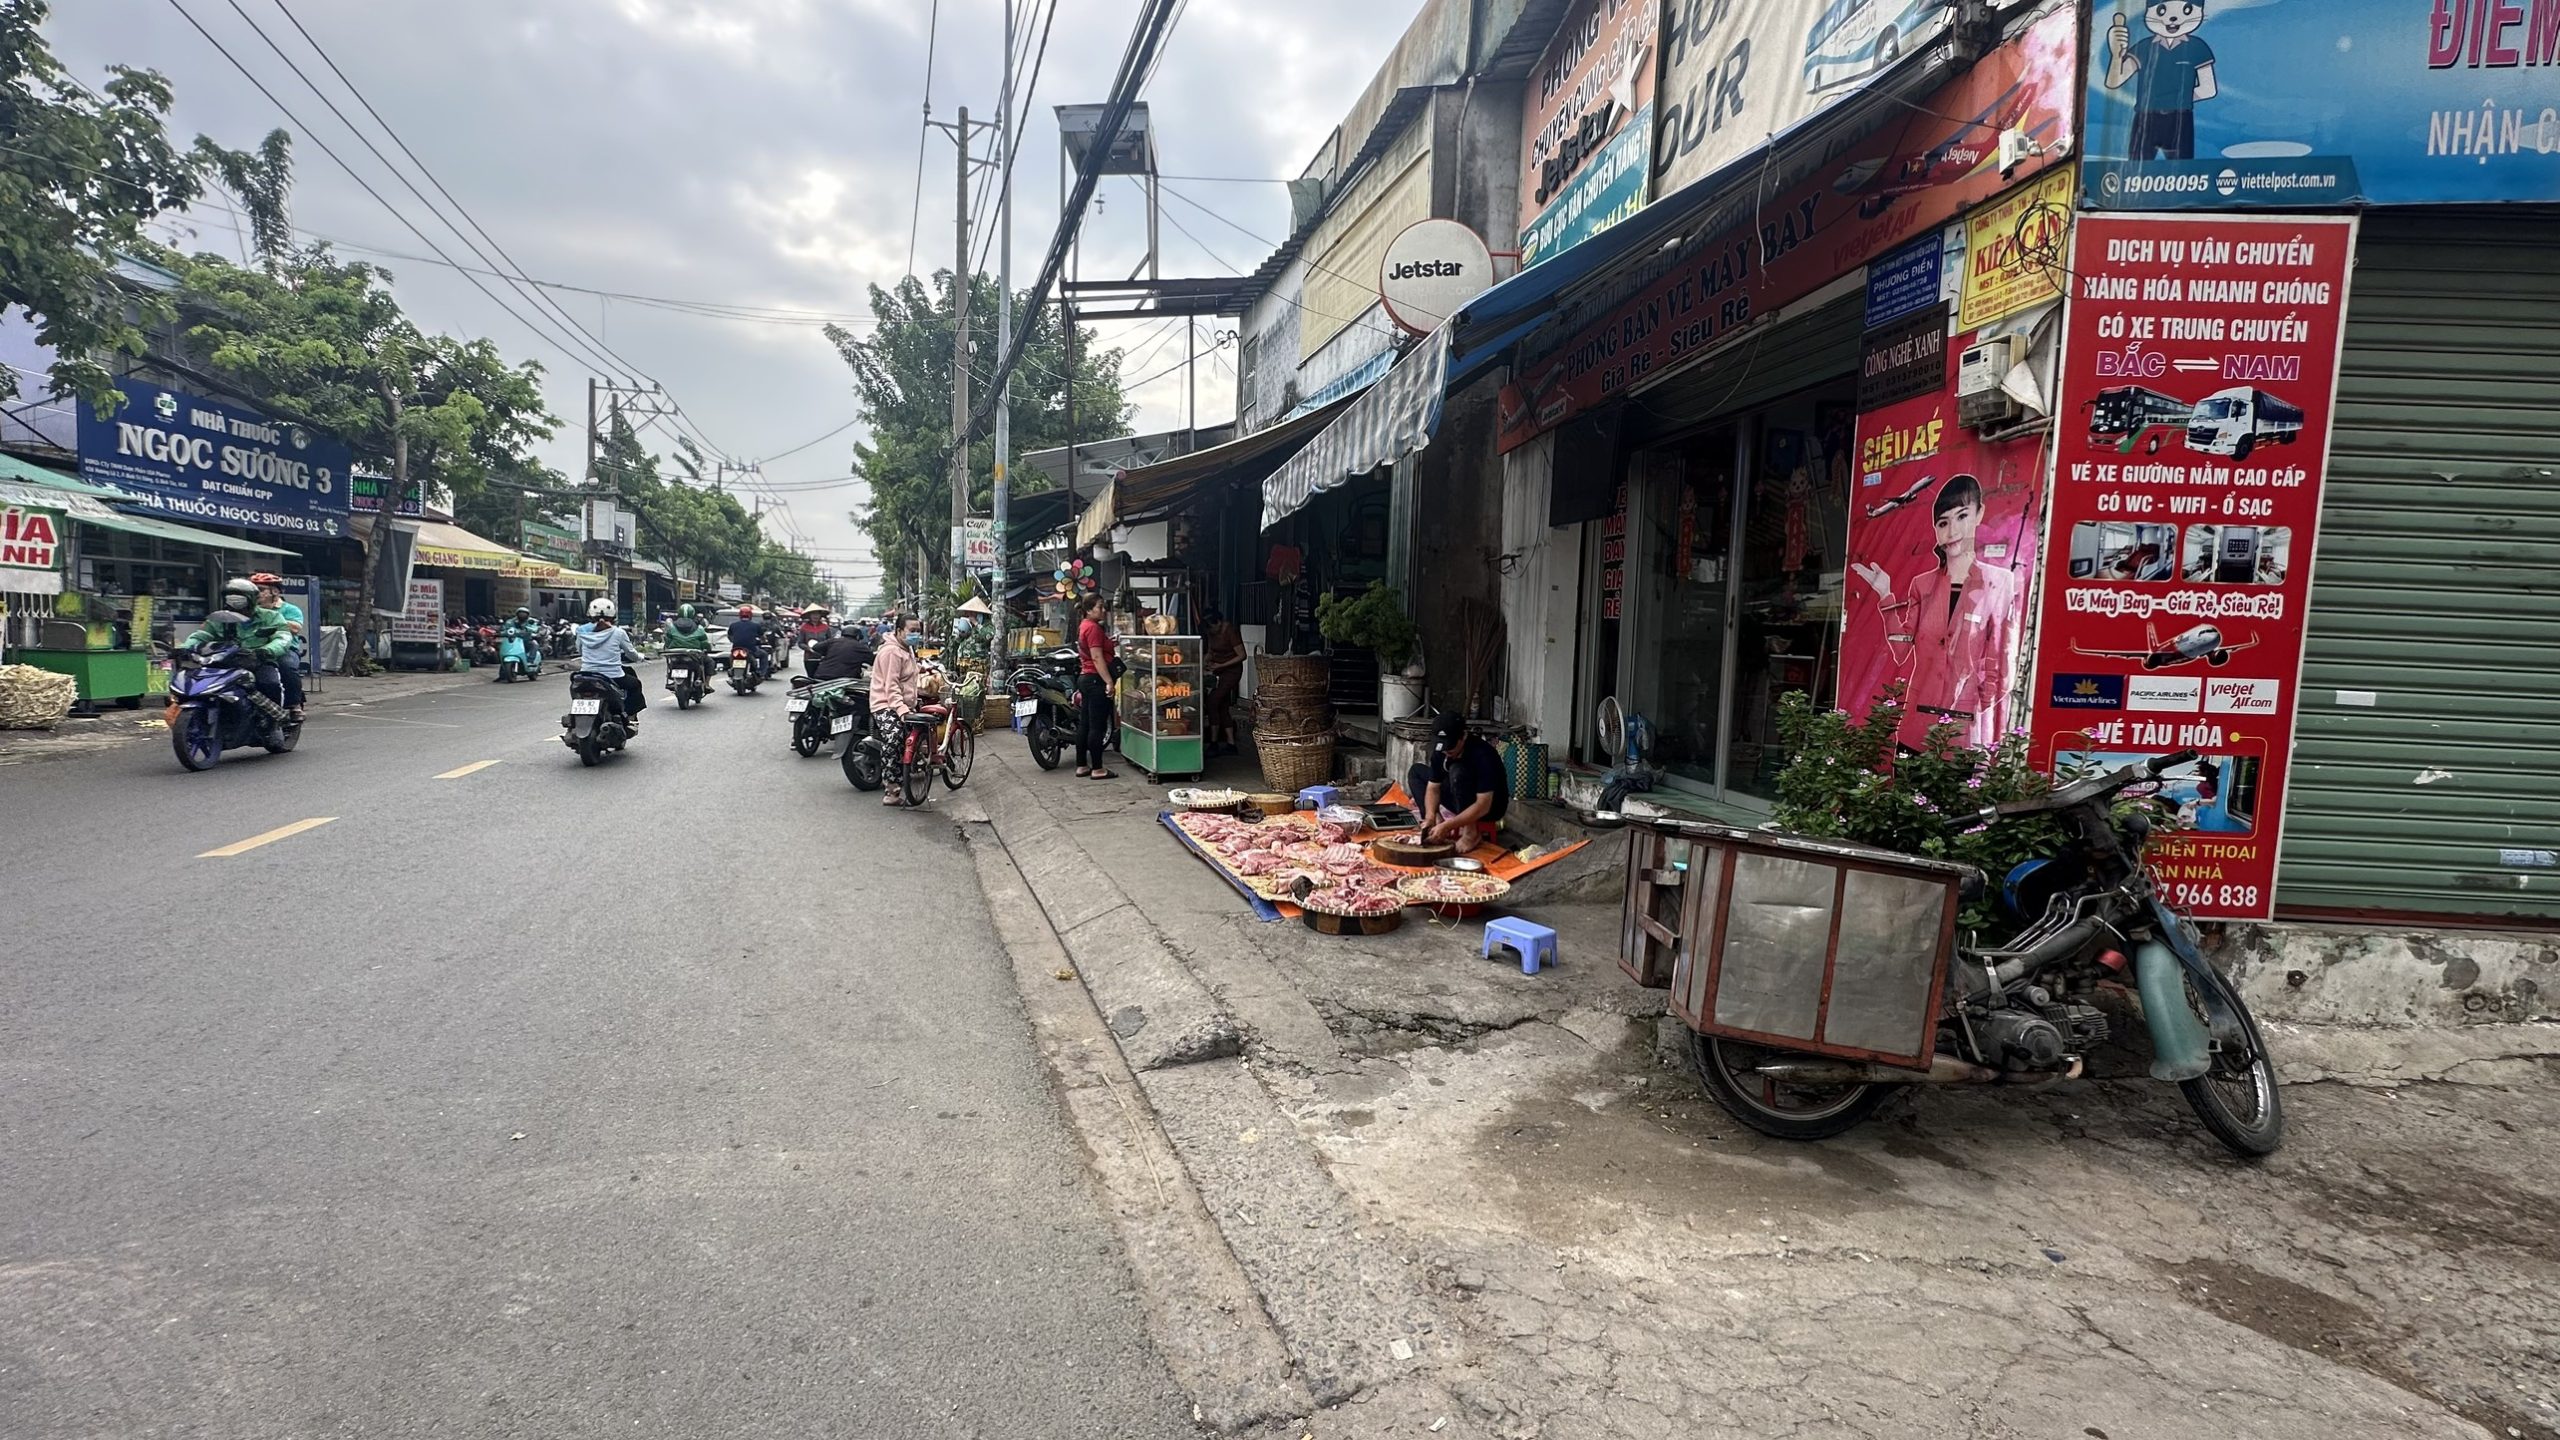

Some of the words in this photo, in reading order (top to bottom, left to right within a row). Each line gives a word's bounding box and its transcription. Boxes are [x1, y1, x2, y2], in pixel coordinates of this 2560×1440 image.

[1539, 7, 1601, 113] PHÒNG
[1572, 52, 1606, 123] CUNG
[2427, 98, 2523, 164] NHẬN
[2536, 107, 2560, 155] C
[1535, 100, 1616, 204] Jetstar
[2123, 174, 2209, 193] 19008095
[2241, 172, 2336, 191] viettelpost.com.vn
[2107, 239, 2153, 267] DỊCH
[2159, 241, 2184, 269] VỤ
[2190, 237, 2230, 269] VẬN
[2235, 234, 2315, 266] CHUYỂN
[1389, 260, 1463, 280] Jetstar
[1566, 326, 1619, 383] PHÒNG
[1622, 299, 1661, 348] BÁN
[1666, 266, 1694, 322] VÉ
[1699, 237, 1753, 304] MÁY
[1759, 190, 1822, 267] BAY
[2085, 276, 2137, 300] HÀNG
[2143, 275, 2182, 303] HÓA
[2188, 280, 2257, 304] NHANH
[2262, 278, 2330, 305] CHÓNG
[1601, 359, 1625, 395] Giá
[1630, 340, 1652, 380] Rẻ
[1670, 315, 1713, 358] Siêu
[1720, 286, 1750, 331] Rẻ
[2098, 311, 2125, 339] CÓ
[2129, 316, 2155, 339] XE
[2161, 317, 2225, 341] TRUNG
[2229, 311, 2308, 343] CHUYỂN
[1865, 347, 1888, 378] CÔNG
[1888, 333, 1913, 369] NGHỆ
[1914, 328, 1941, 361] XANH
[2096, 342, 2166, 378] BẮC
[2222, 354, 2301, 381] NAM
[190, 408, 227, 433] NHÀ
[228, 418, 281, 446] THUỐC
[117, 422, 213, 473] NGỌC
[220, 445, 310, 490] SƯƠNG
[316, 467, 332, 494] 3
[2071, 462, 2092, 481] VÉ
[2095, 464, 2117, 483] XE
[2121, 462, 2185, 485] GIƯỜNG
[2189, 463, 2229, 486] NẰM
[2233, 468, 2266, 487] CAO
[2271, 464, 2306, 487] CẤP
[202, 480, 221, 493] ĐẠT
[223, 481, 253, 498] CHUẨN
[254, 485, 273, 501] GPP
[2097, 491, 2121, 513] CÓ
[2125, 495, 2152, 514] WC
[2169, 496, 2206, 515] WIFI
[2222, 491, 2235, 515] Ổ
[2239, 497, 2272, 519] SẠC
[0, 507, 56, 545] ÍA
[166, 495, 217, 517] THUỐC
[220, 506, 260, 525] NGỌC
[262, 511, 304, 530] SƯƠNG
[305, 518, 320, 532] 03
[0, 545, 50, 565] NH
[432, 552, 459, 566] GIANG
[2068, 591, 2086, 609] Vé
[2089, 590, 2118, 616] Máy
[2123, 592, 2150, 616] Bay
[2167, 592, 2192, 612] Giá
[2222, 594, 2252, 614] Siêu
[2256, 594, 2281, 616] Rẻ!
[2053, 694, 2087, 705] Vietnam
[2087, 696, 2118, 706] Airlines
[2130, 690, 2157, 698] PACIFIC
[2157, 691, 2188, 699] AIRLINES
[2098, 718, 2125, 744] VÉ
[2131, 720, 2173, 747] TÀU
[2178, 718, 2223, 748] HỎA
[2201, 844, 2257, 863] THOẠI
[2184, 864, 2223, 880] NHÀ
[2176, 884, 2214, 906] 966
[2219, 886, 2257, 907] 838
